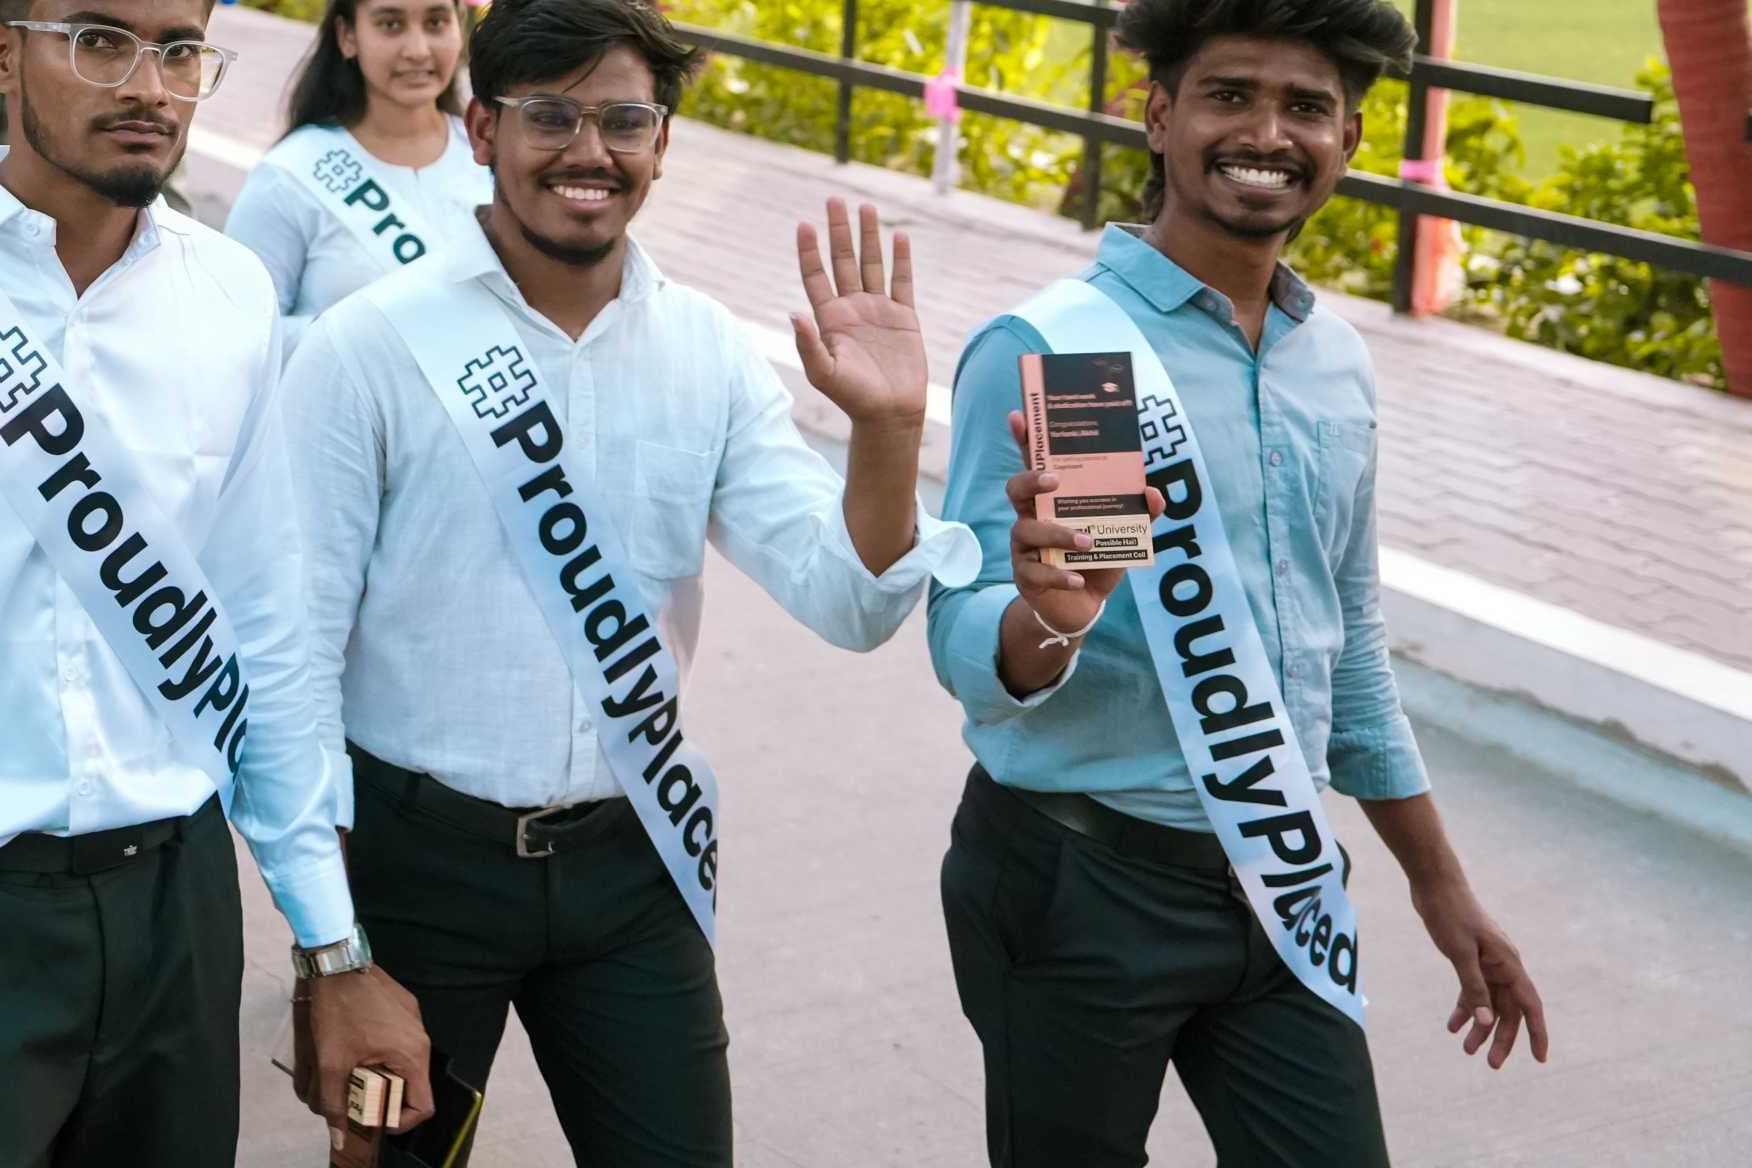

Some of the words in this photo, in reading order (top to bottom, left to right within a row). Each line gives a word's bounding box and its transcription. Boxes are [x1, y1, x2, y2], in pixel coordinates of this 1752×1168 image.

[1097, 524, 1148, 536] University
[1067, 553, 1093, 561] Training
[1099, 552, 1134, 560] Placement
[457, 345, 718, 914] #ProudlyPlace
